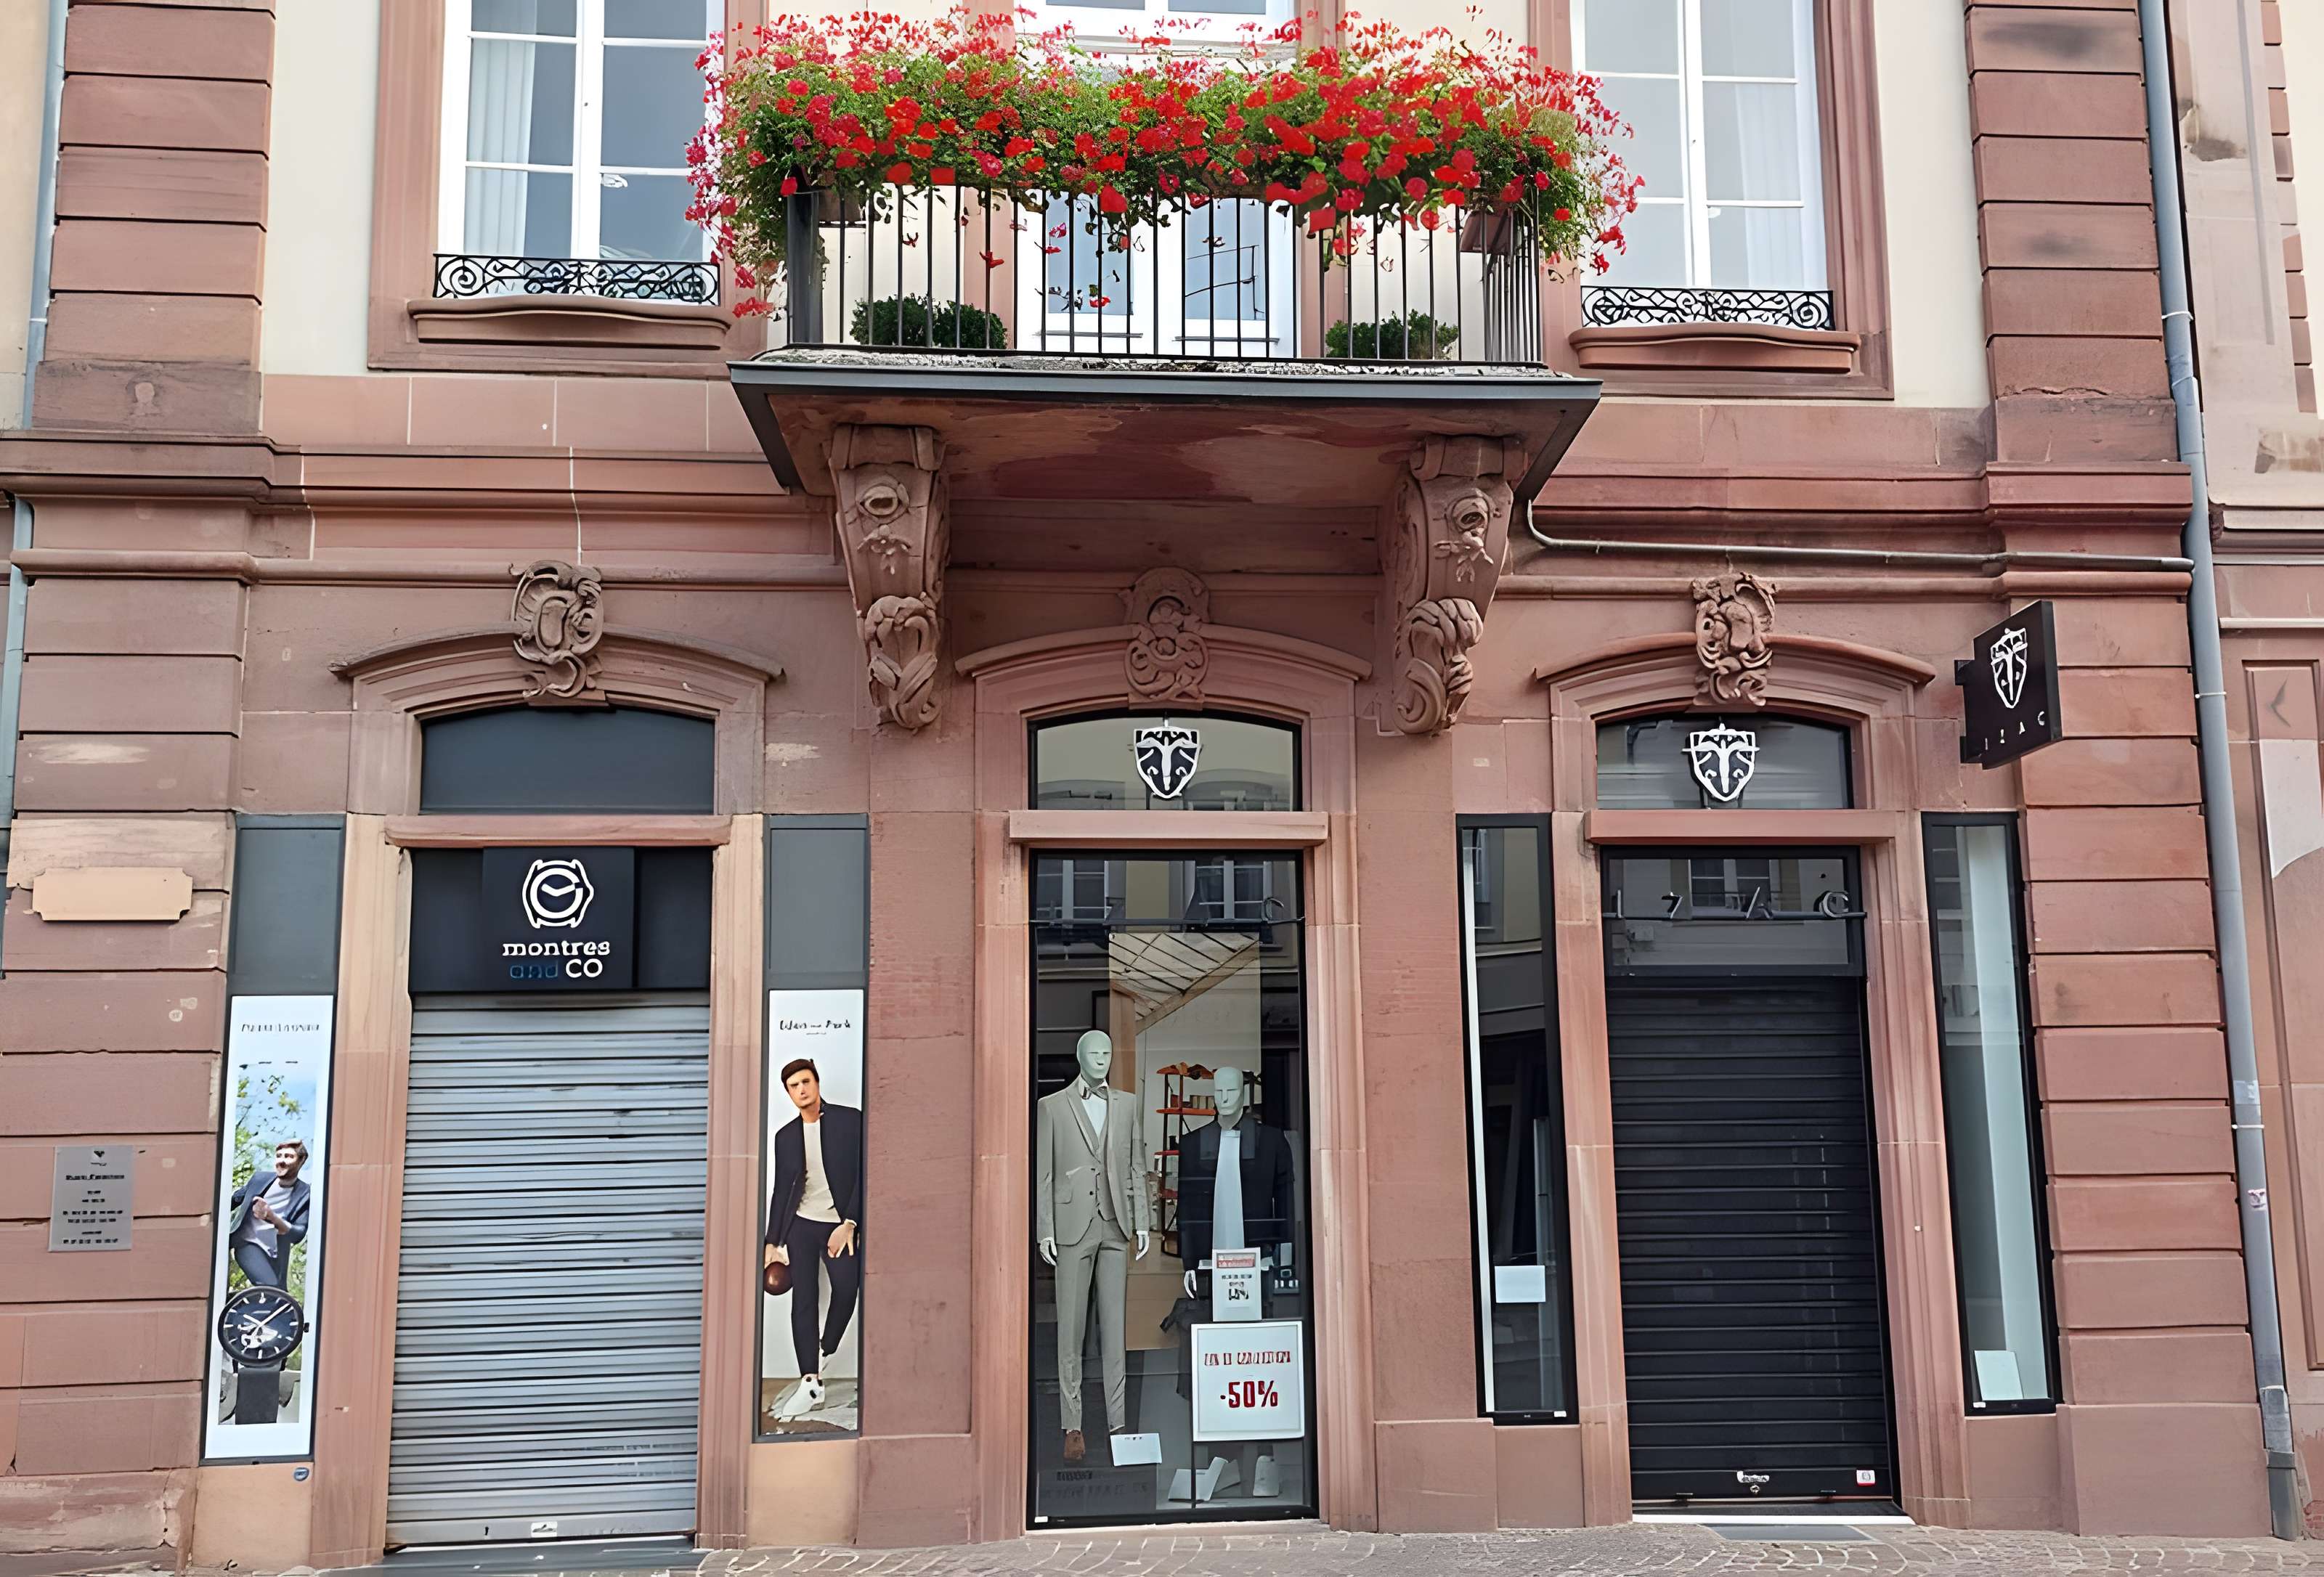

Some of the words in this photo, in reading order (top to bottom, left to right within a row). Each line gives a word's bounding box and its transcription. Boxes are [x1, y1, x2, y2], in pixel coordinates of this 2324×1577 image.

[502, 940, 611, 956] montres
[565, 958, 604, 978] CO
[1220, 1380, 1278, 1409] -50%
